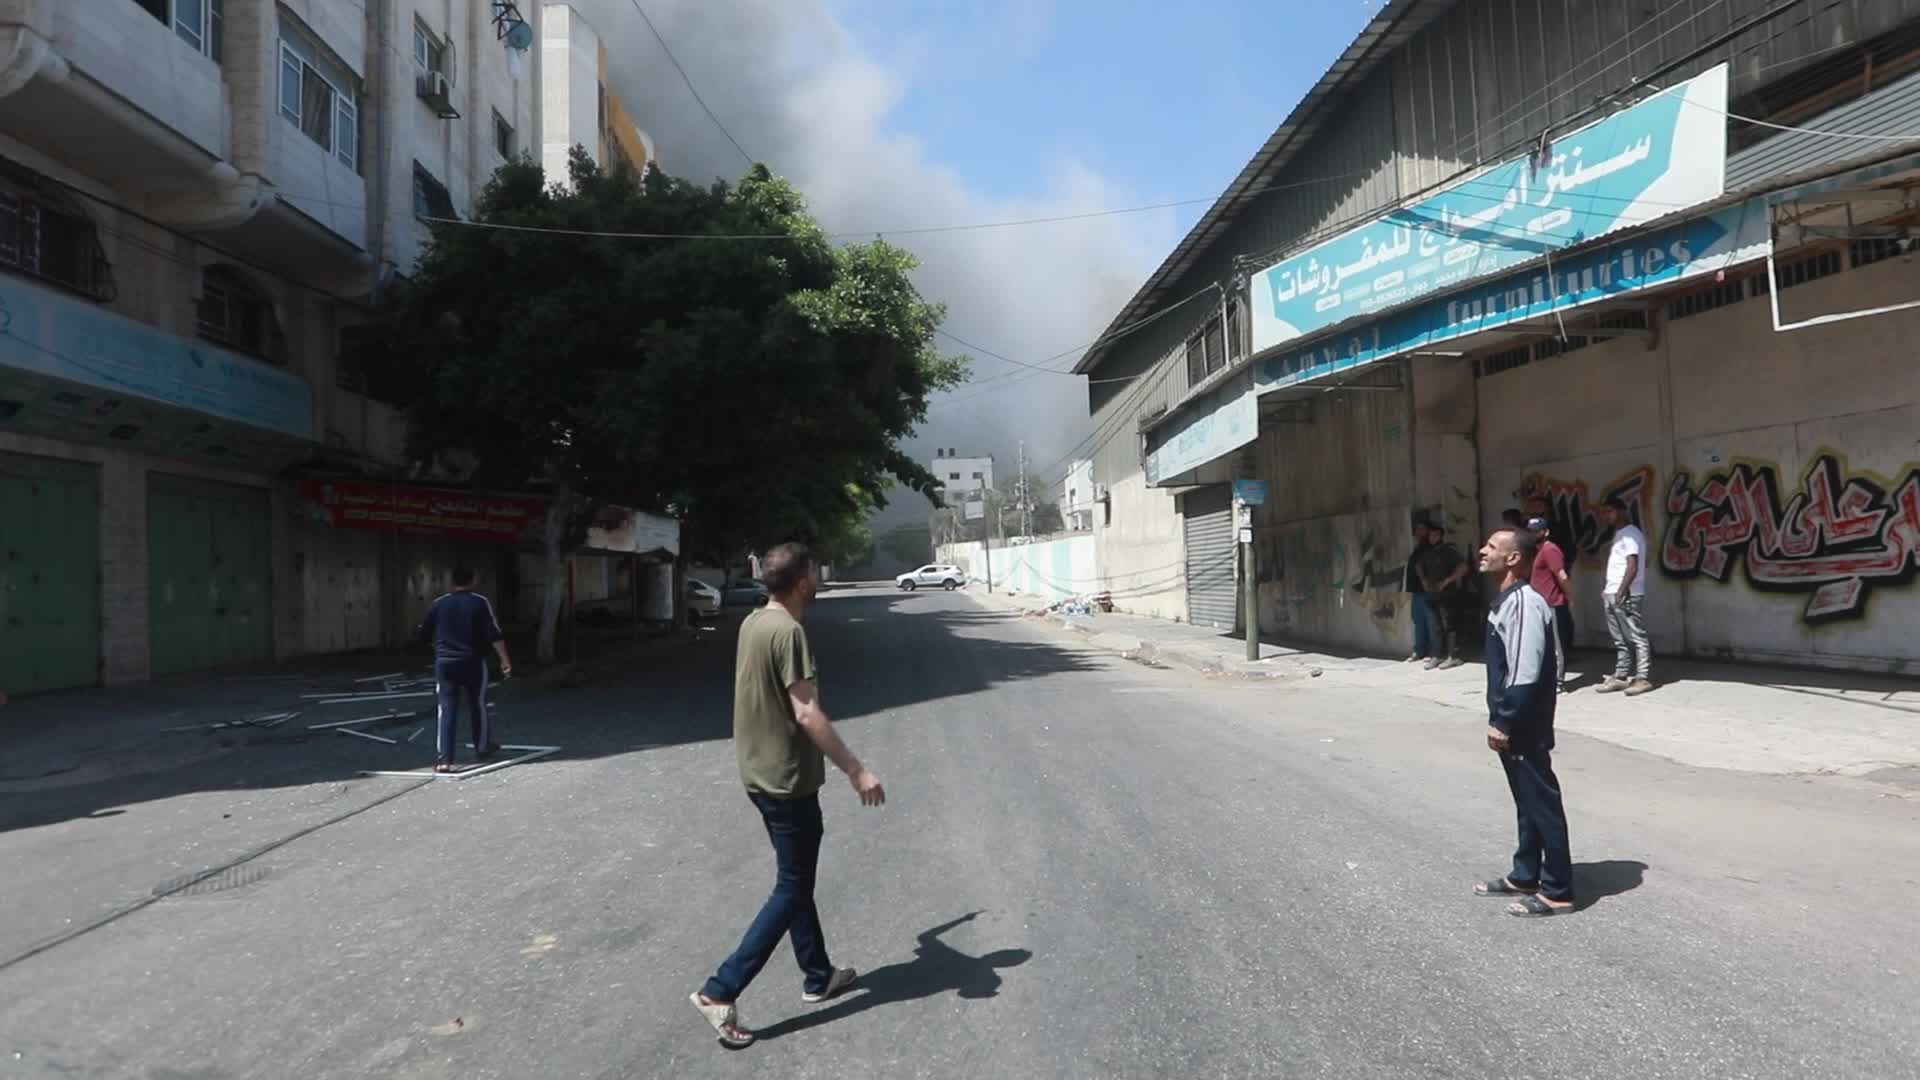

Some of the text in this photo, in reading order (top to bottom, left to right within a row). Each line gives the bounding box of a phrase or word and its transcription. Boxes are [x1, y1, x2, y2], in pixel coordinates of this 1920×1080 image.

[1534, 132, 1652, 207] سنتر
[1278, 221, 1411, 302] للمفروشات
[1662, 464, 1780, 580] النبي
[1778, 455, 1888, 558] على
